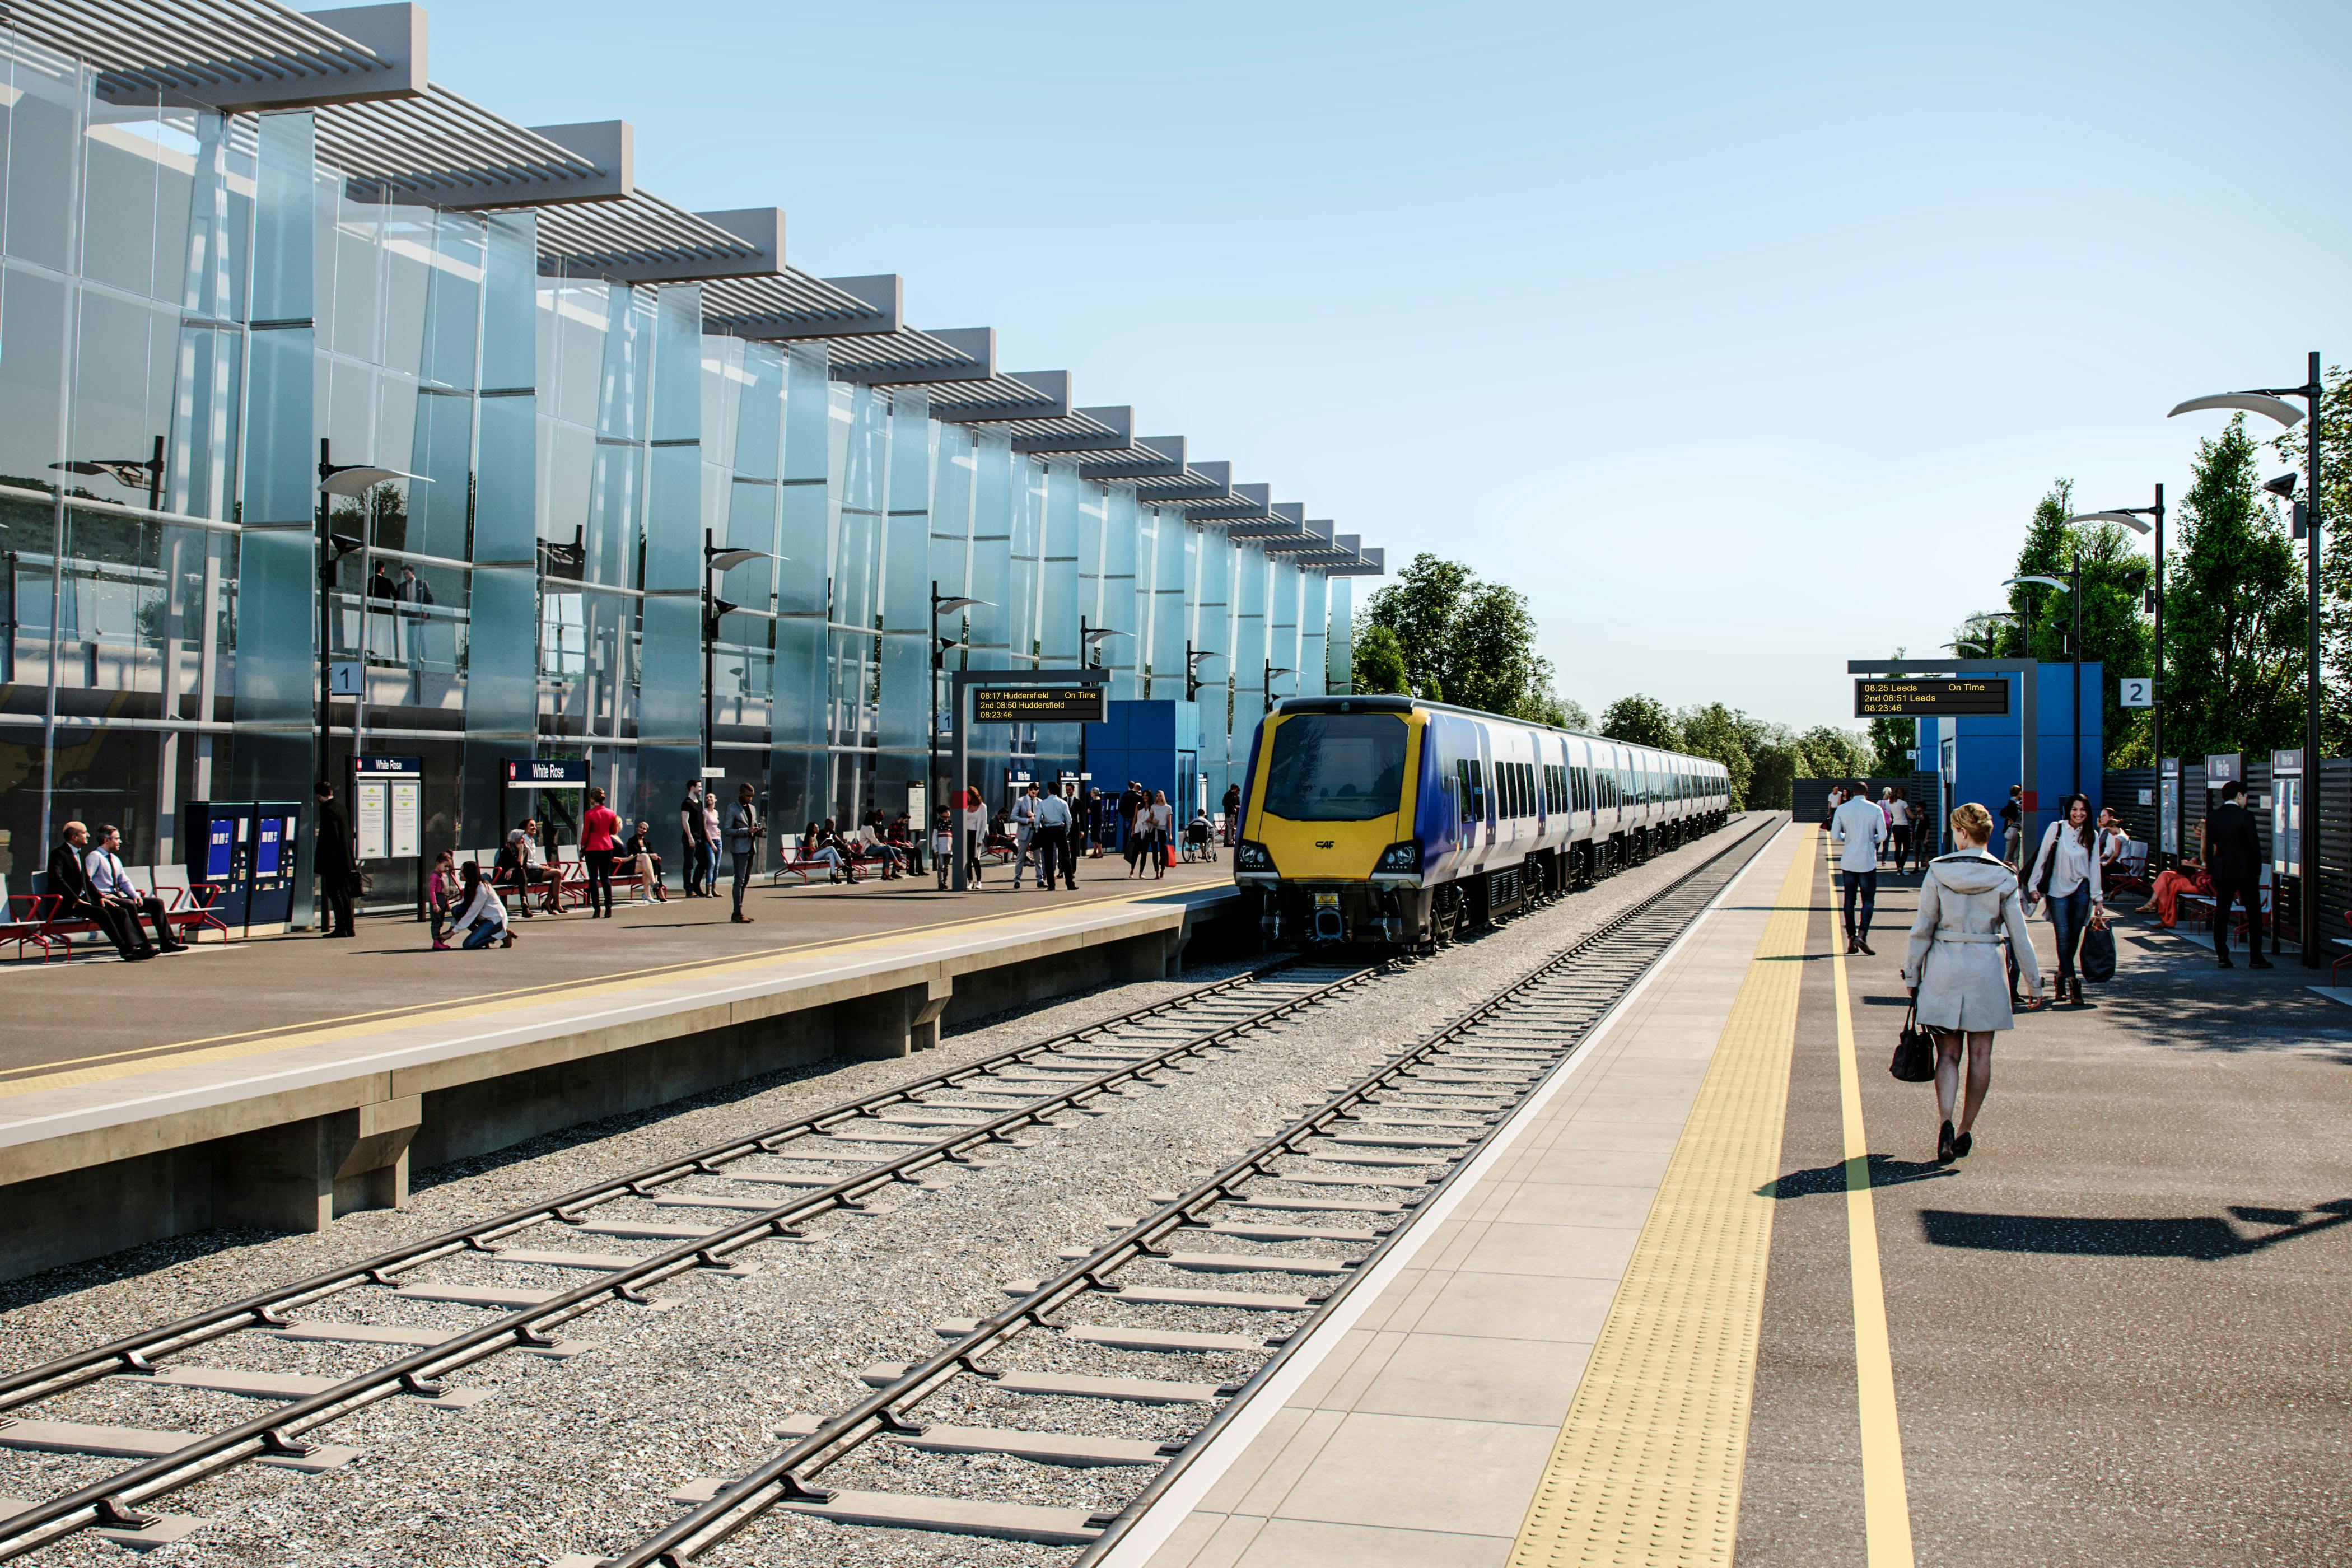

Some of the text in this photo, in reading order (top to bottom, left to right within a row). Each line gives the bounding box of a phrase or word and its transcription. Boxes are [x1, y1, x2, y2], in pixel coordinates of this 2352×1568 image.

[340, 667, 348, 689] 1
[2130, 683, 2143, 702] 2
[945, 715, 950, 729] 1
[375, 759, 402, 770] White Rose
[533, 764, 564, 778] White Rose
[1315, 841, 1334, 850] CAF
